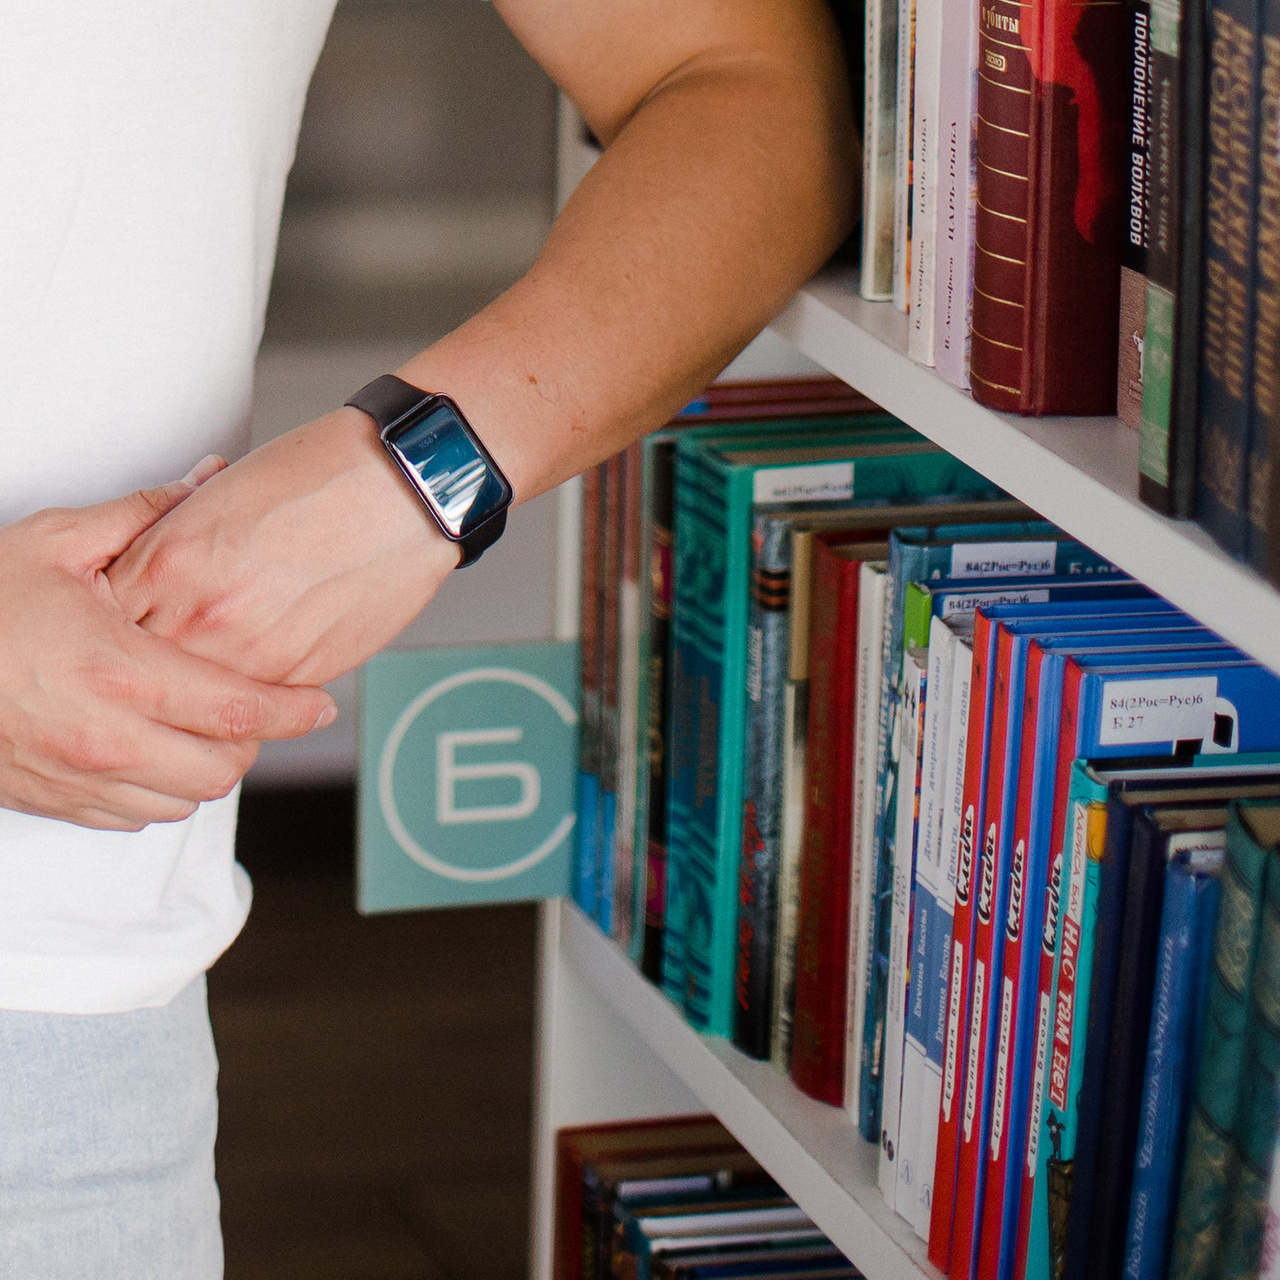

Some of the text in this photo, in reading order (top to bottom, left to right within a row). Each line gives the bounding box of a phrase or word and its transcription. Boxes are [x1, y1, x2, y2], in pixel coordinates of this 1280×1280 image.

[1132, 12, 1148, 147] ПОКЛОНЕНИЕ
[1130, 151, 1144, 246] ВОЛХВОВ
[1127, 715, 1144, 729] 27
[436, 728, 540, 824] Б
[1073, 807, 1085, 876] ЛАРИСА
[916, 908, 928, 956] Басова
[1070, 884, 1081, 918] БАУ
[913, 962, 924, 1019] Евгения
[938, 933, 950, 982] Басова
[944, 815, 972, 1100] Евгения Басова Следы
[965, 834, 995, 1121] Евгения Басова Следы
[992, 851, 1023, 1139] Евгения Басова Следы
[934, 987, 947, 1043] Евгения
[1029, 864, 1061, 1155] Евгения Басова Следы
